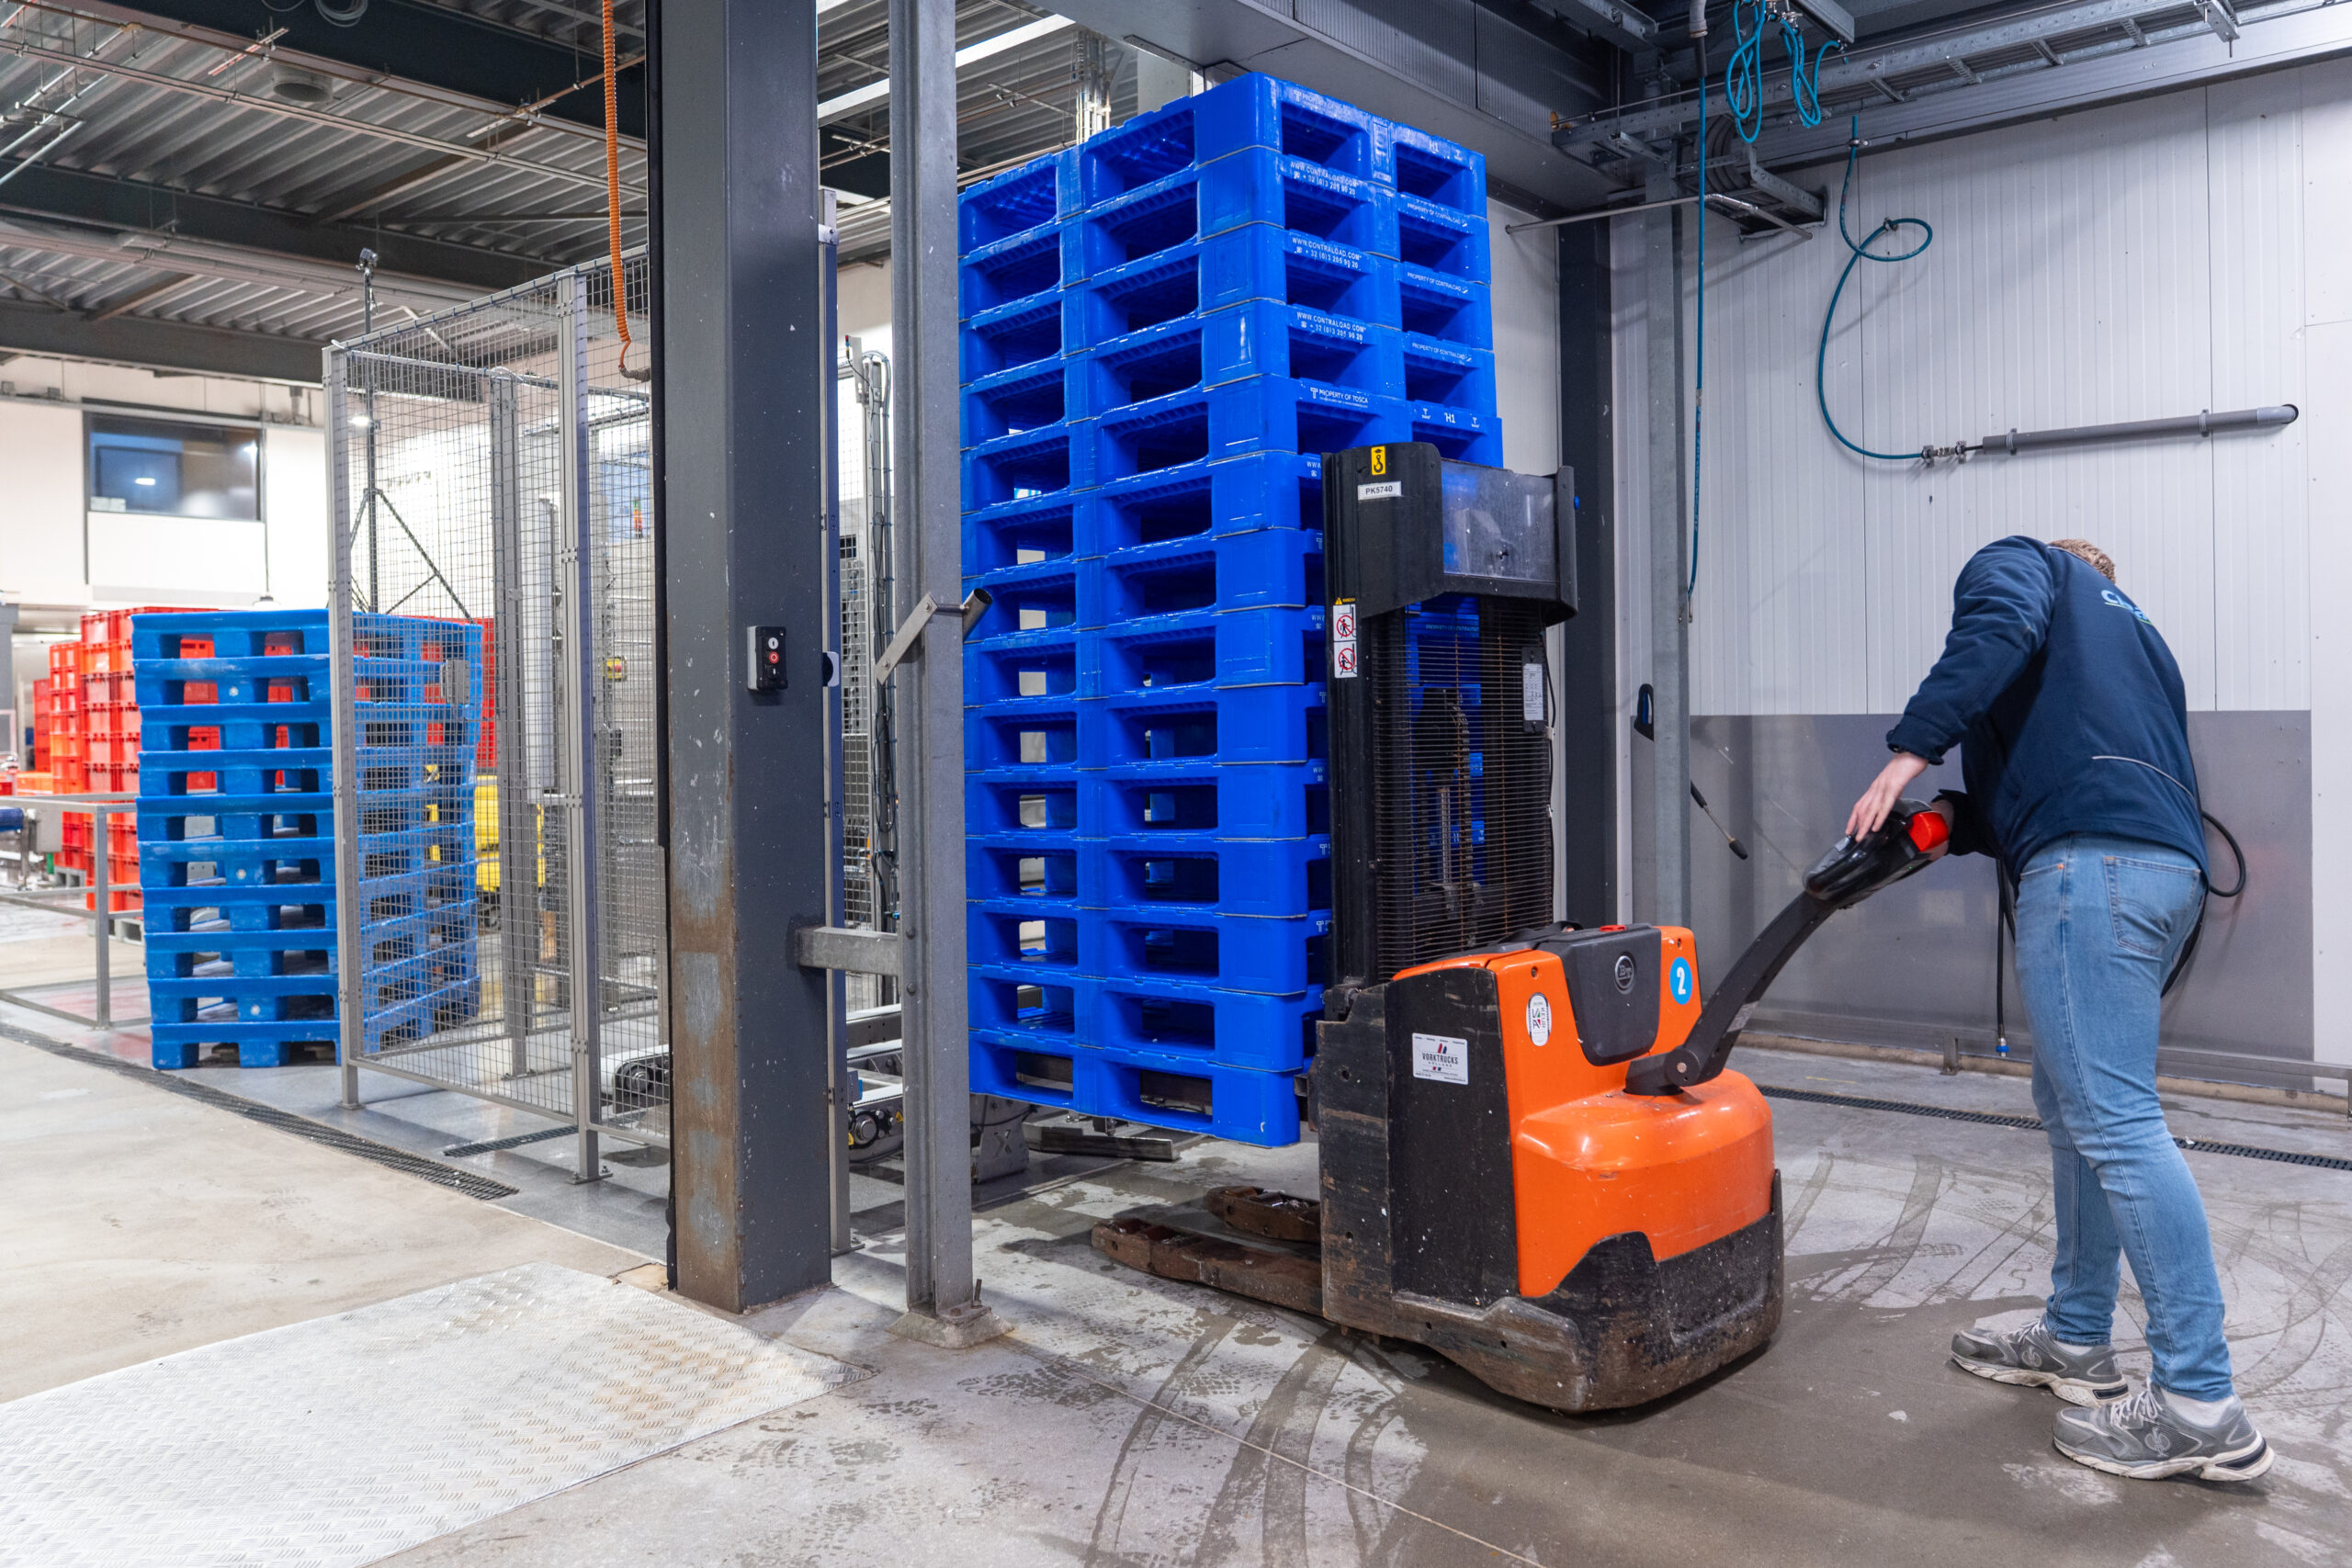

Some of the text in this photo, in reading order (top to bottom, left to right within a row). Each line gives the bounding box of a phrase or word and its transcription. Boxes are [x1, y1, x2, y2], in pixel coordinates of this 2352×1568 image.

[1311, 249, 1317, 257] 32
[1332, 255, 1342, 265] 205
[1351, 261, 1359, 269] 20
[1407, 272, 1429, 282] PROPERTY
[1435, 280, 1462, 292] CONTRALOAD
[1337, 329, 1347, 338] 205
[1356, 333, 1363, 341] 20
[1411, 342, 1433, 352] PROPERTY
[1440, 348, 1465, 360] CONTRALOAD
[1319, 389, 1343, 399] PROPERTY
[1352, 395, 1368, 403] TOSCA
[1444, 412, 1456, 423] H1
[1365, 485, 1393, 495] PK5740
[1677, 966, 1686, 995] 2
[1422, 1052, 1458, 1066] VORKTRUCKS
